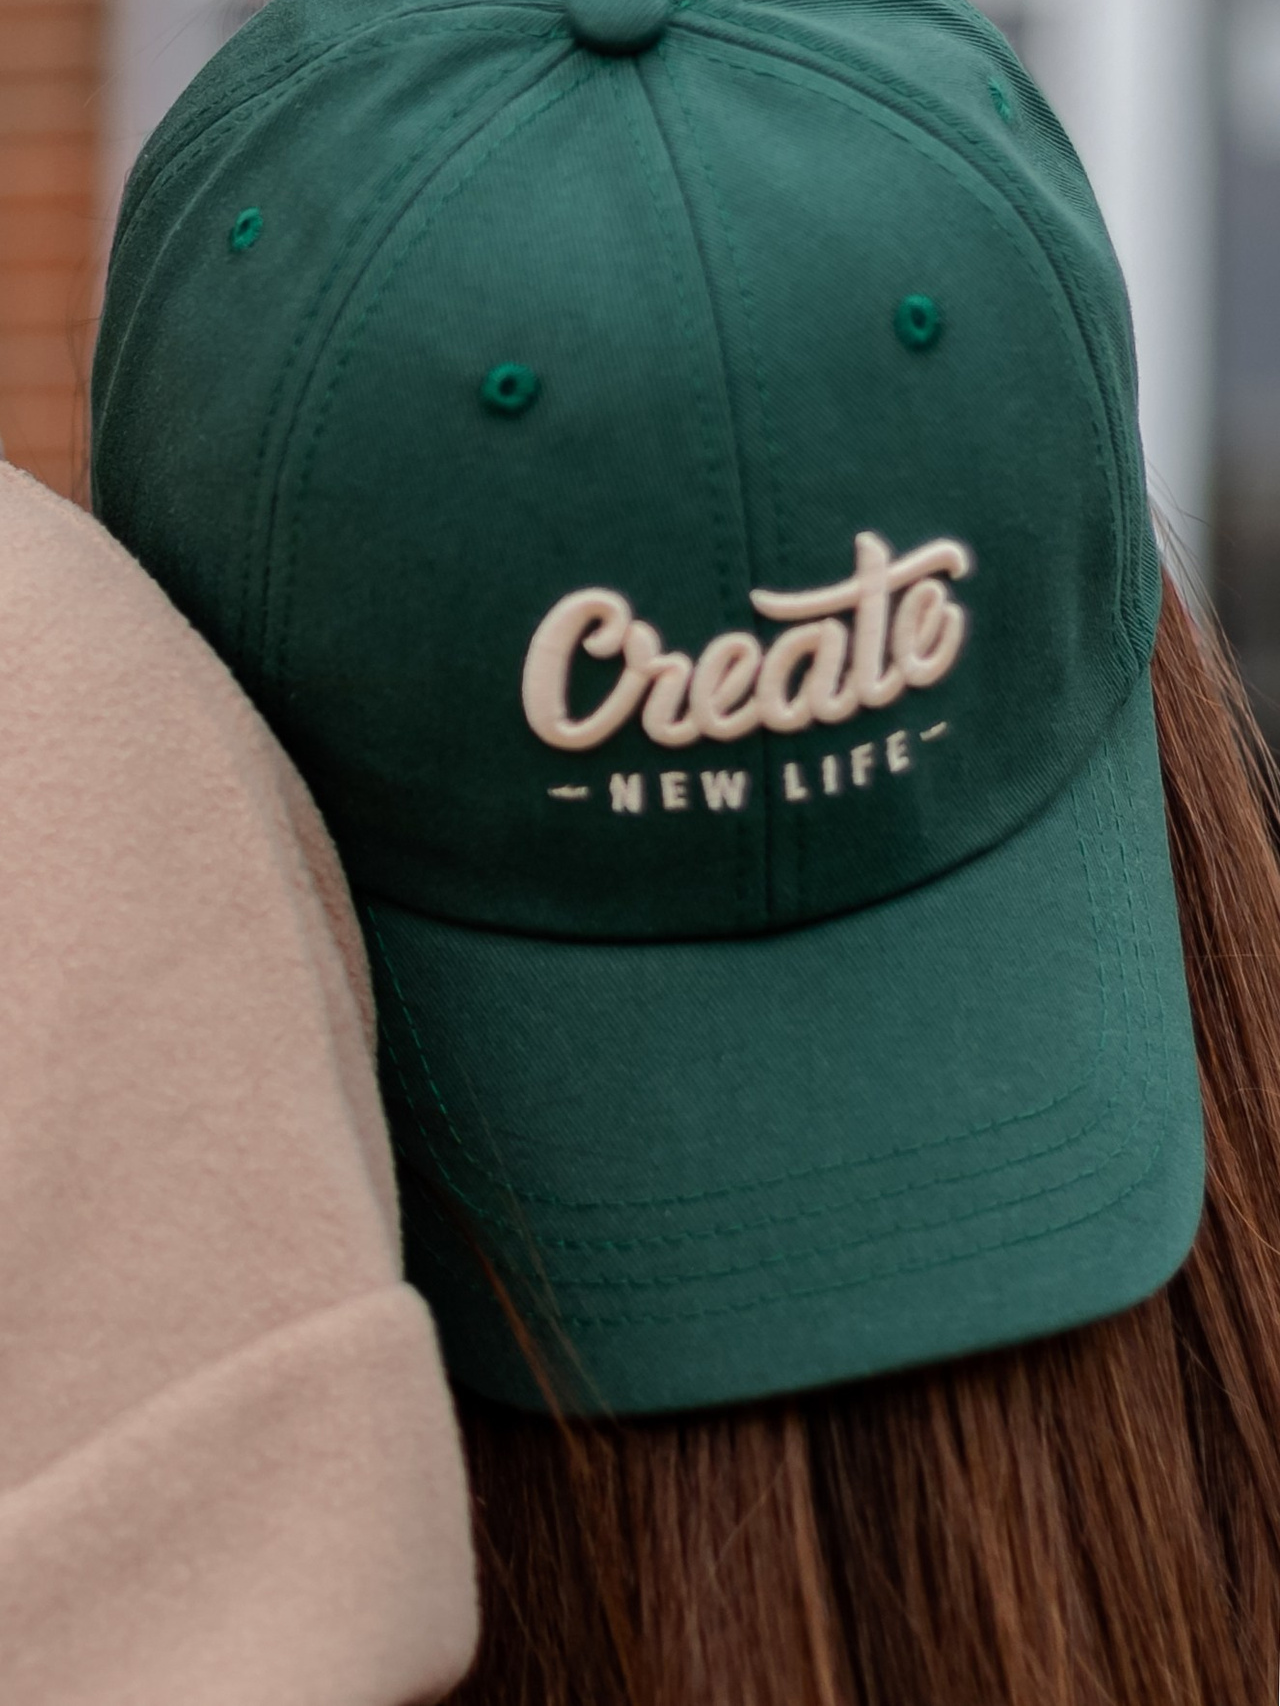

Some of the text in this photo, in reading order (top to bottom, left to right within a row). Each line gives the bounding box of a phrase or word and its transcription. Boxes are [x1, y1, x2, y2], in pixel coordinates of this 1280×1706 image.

[522, 530, 971, 750] Create
[609, 730, 912, 813] NEW LIFE
